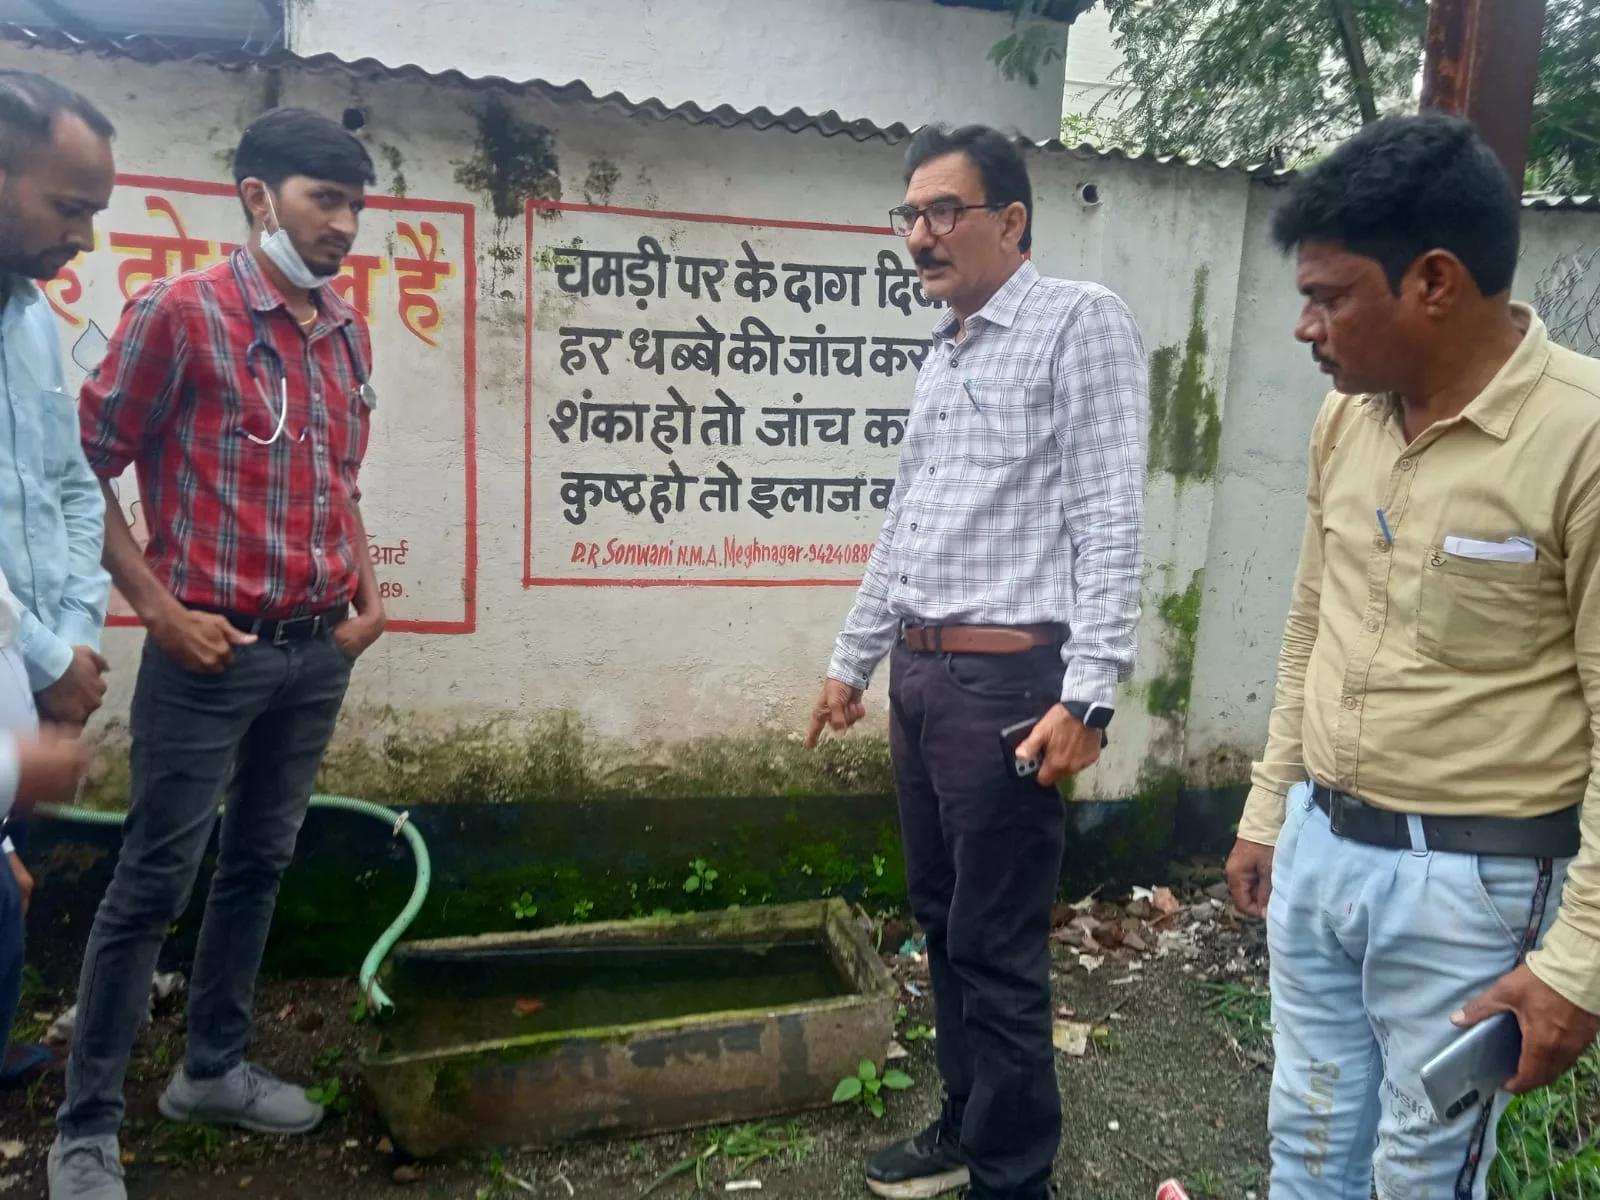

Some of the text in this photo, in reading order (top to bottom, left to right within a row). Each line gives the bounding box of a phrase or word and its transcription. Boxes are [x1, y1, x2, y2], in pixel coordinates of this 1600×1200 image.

[394, 221, 455, 348] है
[553, 236, 671, 310] चमड़ी
[675, 256, 728, 302] पर
[734, 240, 777, 302] के
[782, 263, 866, 313] दाग
[559, 327, 622, 375] हर
[728, 316, 785, 375] की
[784, 324, 866, 377] जांच
[549, 389, 650, 443] शंका
[651, 386, 696, 454] हो
[701, 388, 745, 446] तो
[756, 393, 855, 446] जांच
[650, 460, 699, 523] हो
[700, 461, 742, 512] तो
[748, 476, 867, 519] इलाज
